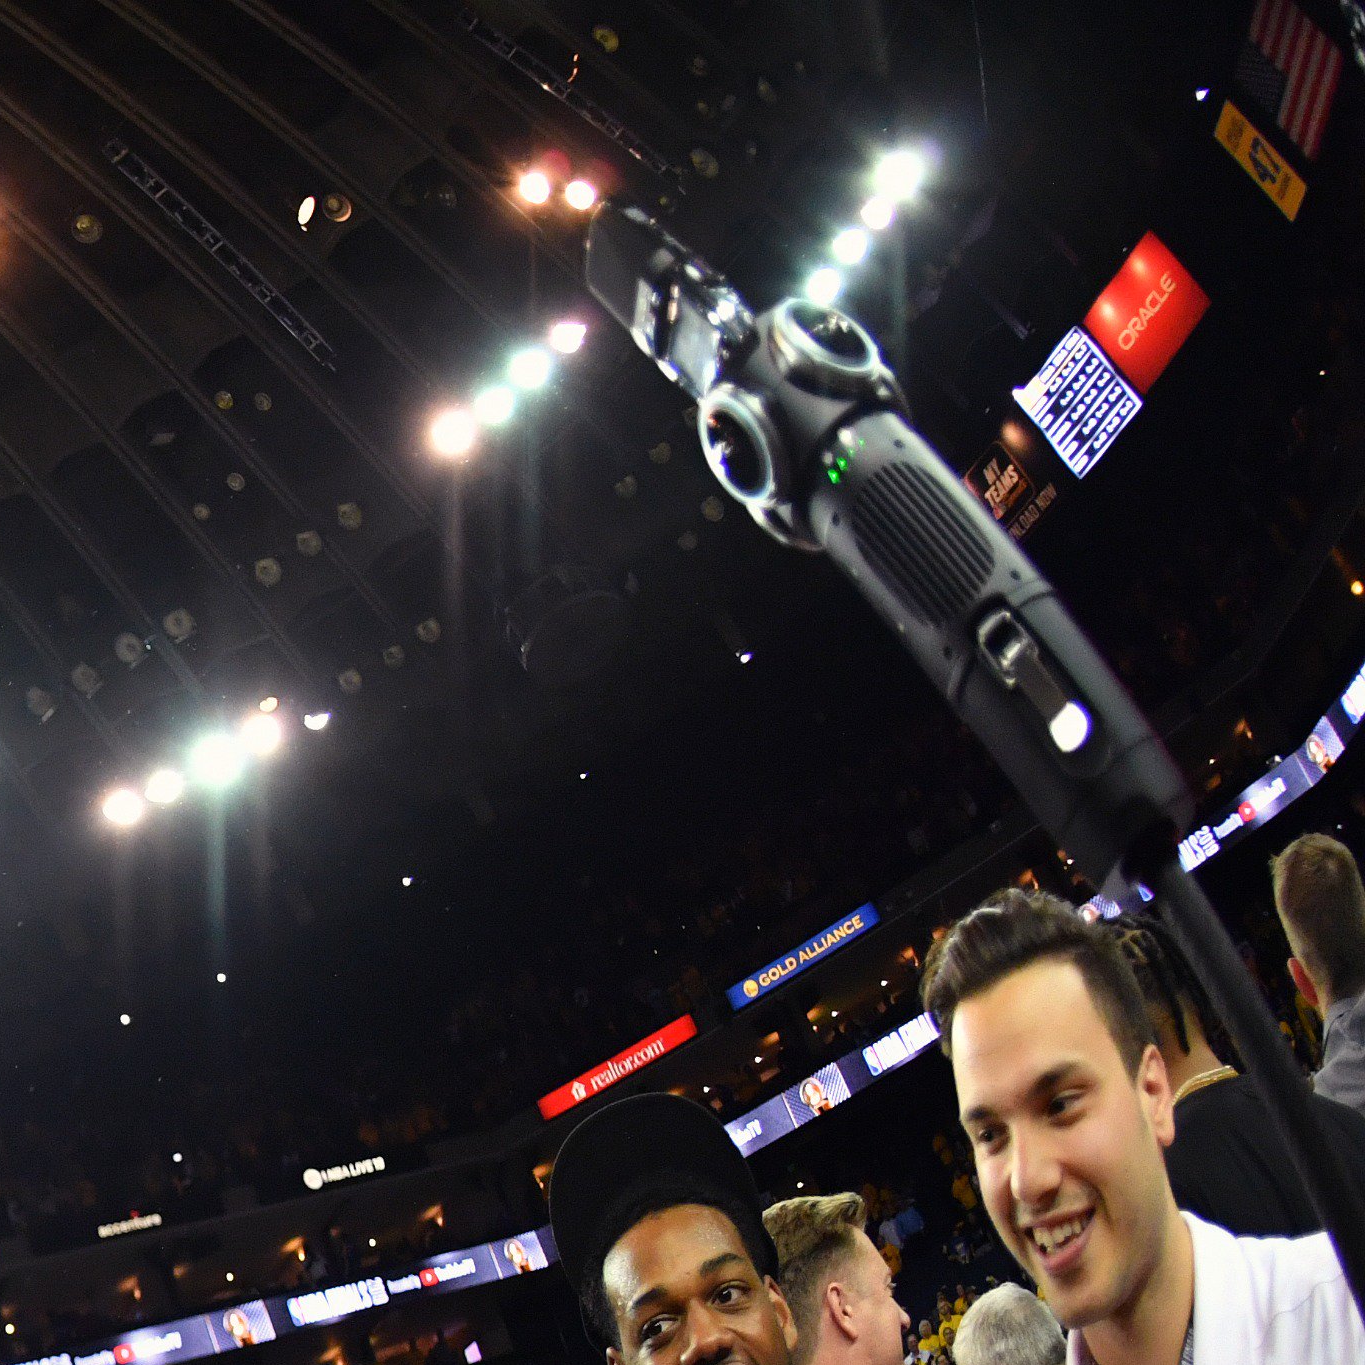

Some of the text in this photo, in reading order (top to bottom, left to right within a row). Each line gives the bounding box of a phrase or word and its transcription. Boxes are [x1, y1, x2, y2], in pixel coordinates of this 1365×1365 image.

[1118, 273, 1177, 351] ORACLE
[984, 464, 1019, 508] TEAMS
[759, 914, 864, 988] GOLD ALLIANCE
[590, 1038, 666, 1091] realtor.com
